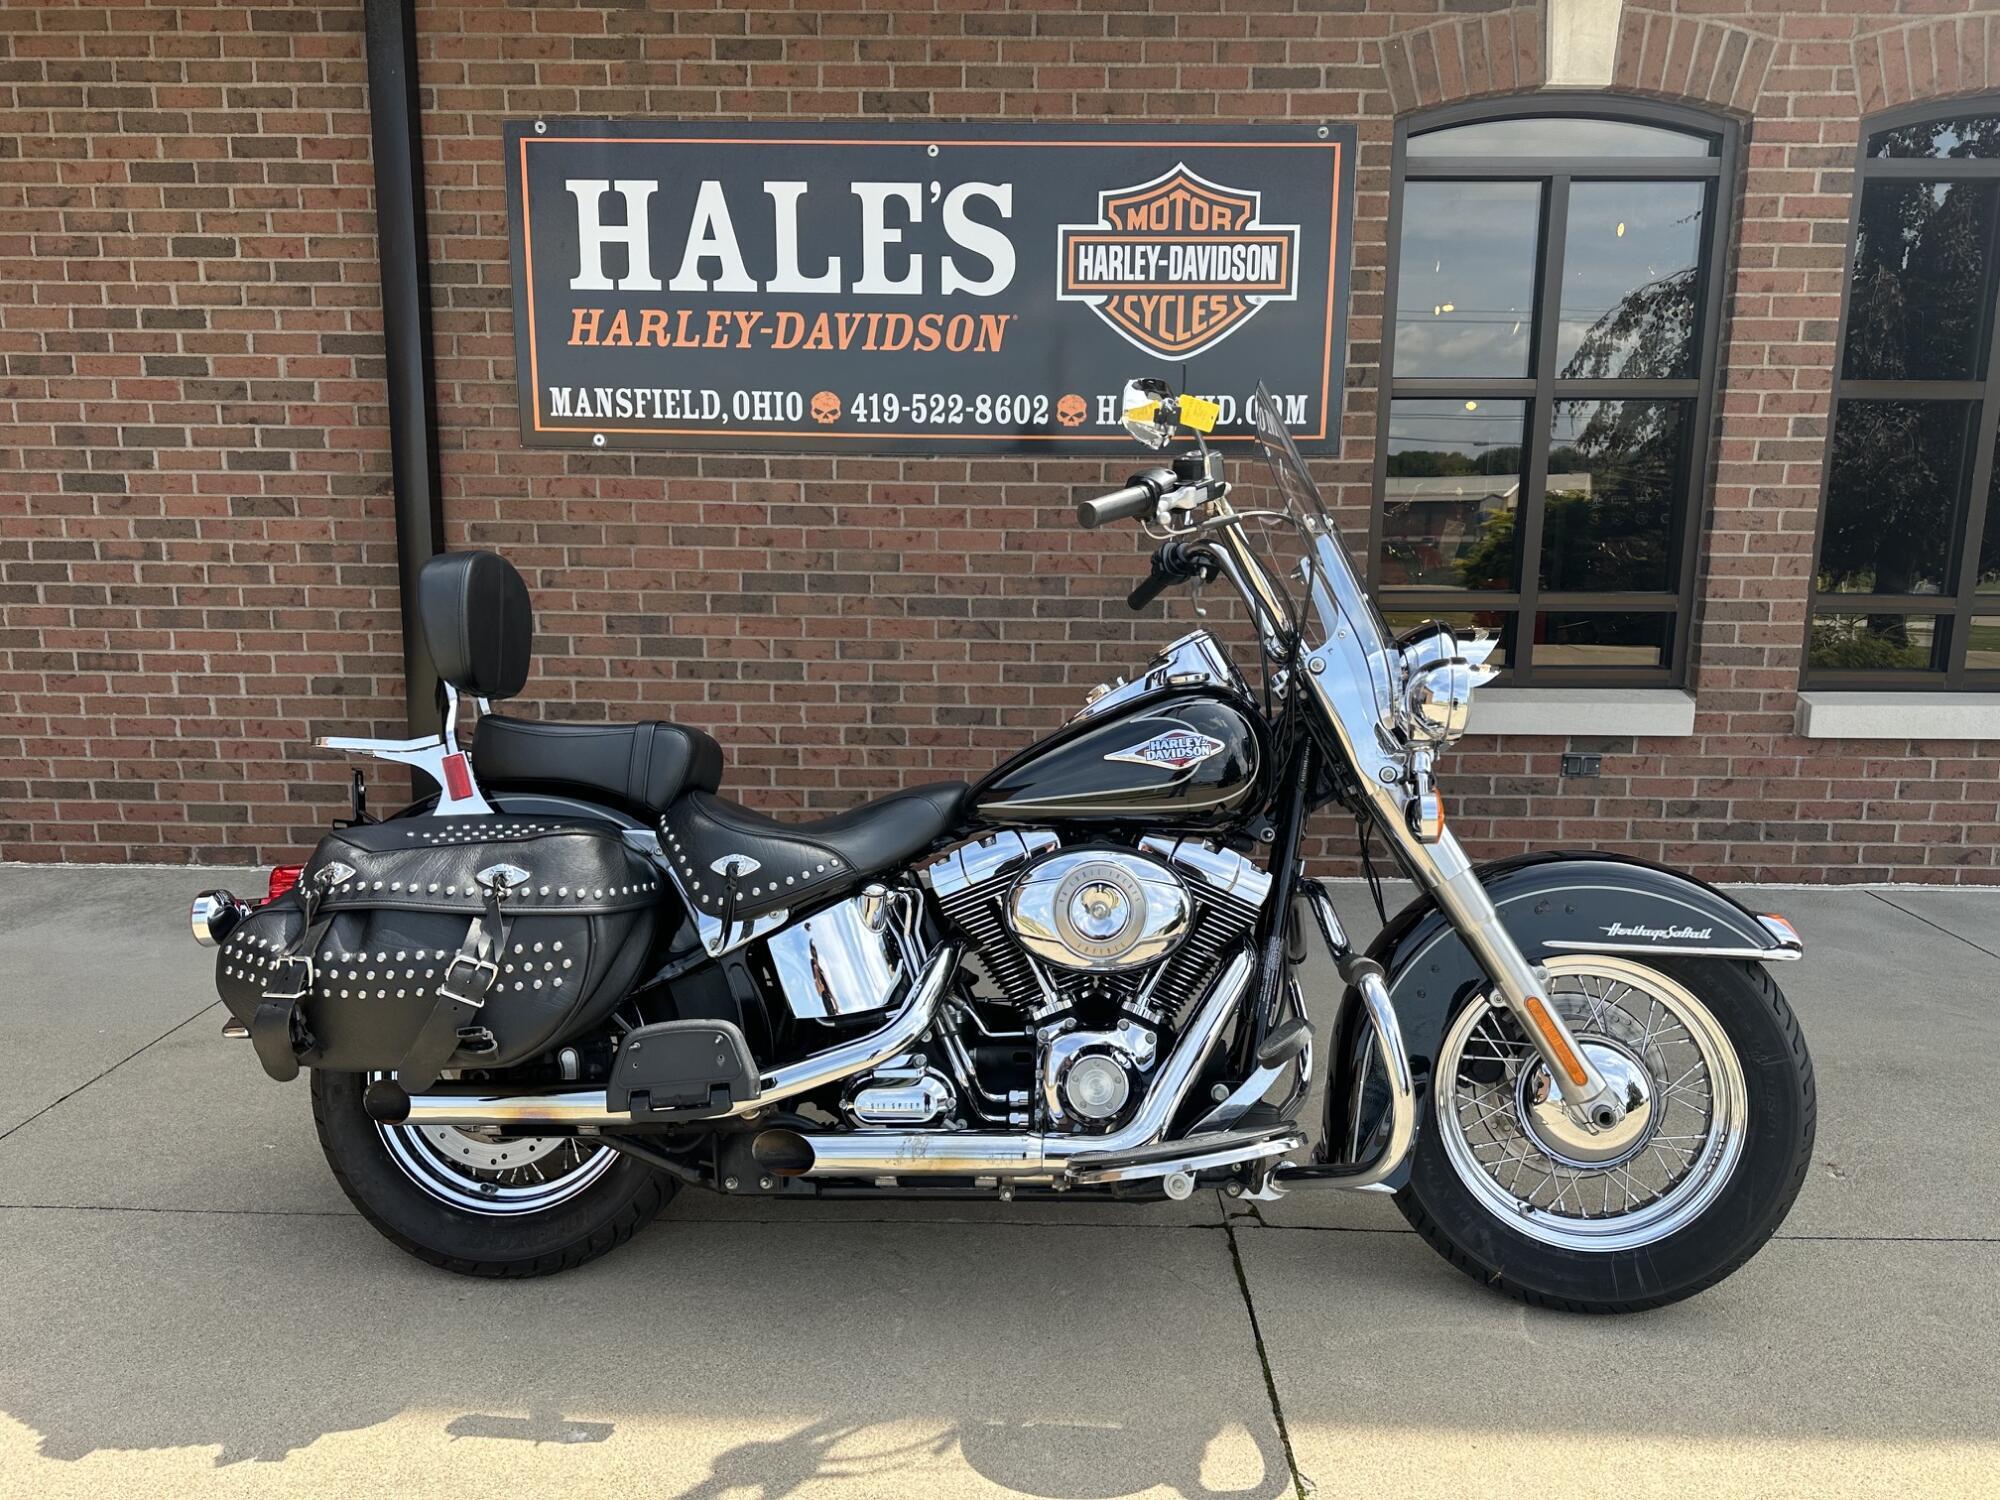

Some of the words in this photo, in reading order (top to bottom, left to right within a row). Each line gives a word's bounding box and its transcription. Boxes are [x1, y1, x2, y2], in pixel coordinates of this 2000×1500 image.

[1127, 188, 1232, 231] MOTOR
[566, 179, 1016, 297] HALE'S
[1078, 243, 1278, 283] HARLEY-DAVIDSON
[568, 308, 1010, 353] HARLEY-DAVIDSON
[1123, 295, 1228, 342] CYCLES
[850, 392, 1049, 426] 419-522-8602
[1146, 745, 1211, 761] DAVIDSON
